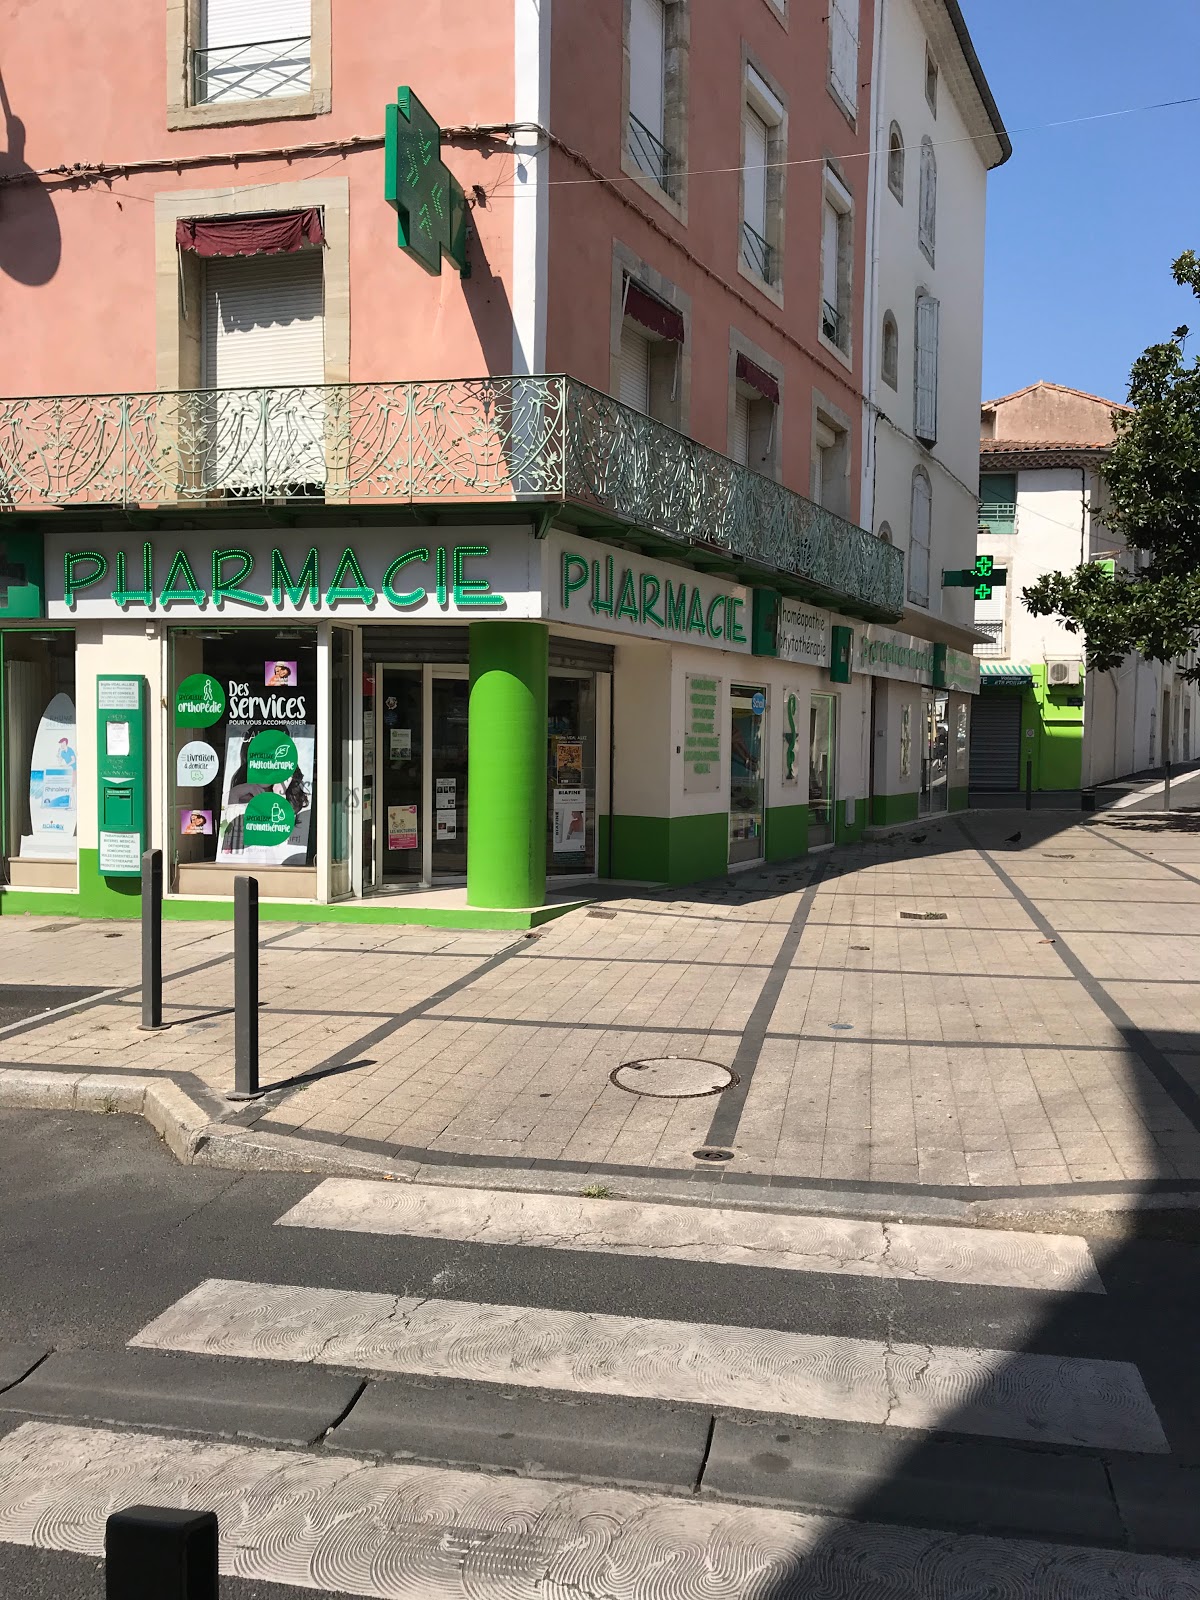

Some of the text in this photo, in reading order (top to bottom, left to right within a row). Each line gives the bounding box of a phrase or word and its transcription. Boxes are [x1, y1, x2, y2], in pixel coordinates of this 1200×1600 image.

[63, 541, 506, 607] PHARMACIE
[561, 552, 748, 643] PHARMACIE
[782, 603, 825, 632] homéopathie
[229, 680, 249, 697] Des
[177, 700, 222, 713] orthopédie
[229, 694, 306, 719] services
[187, 754, 215, 762] Livraison
